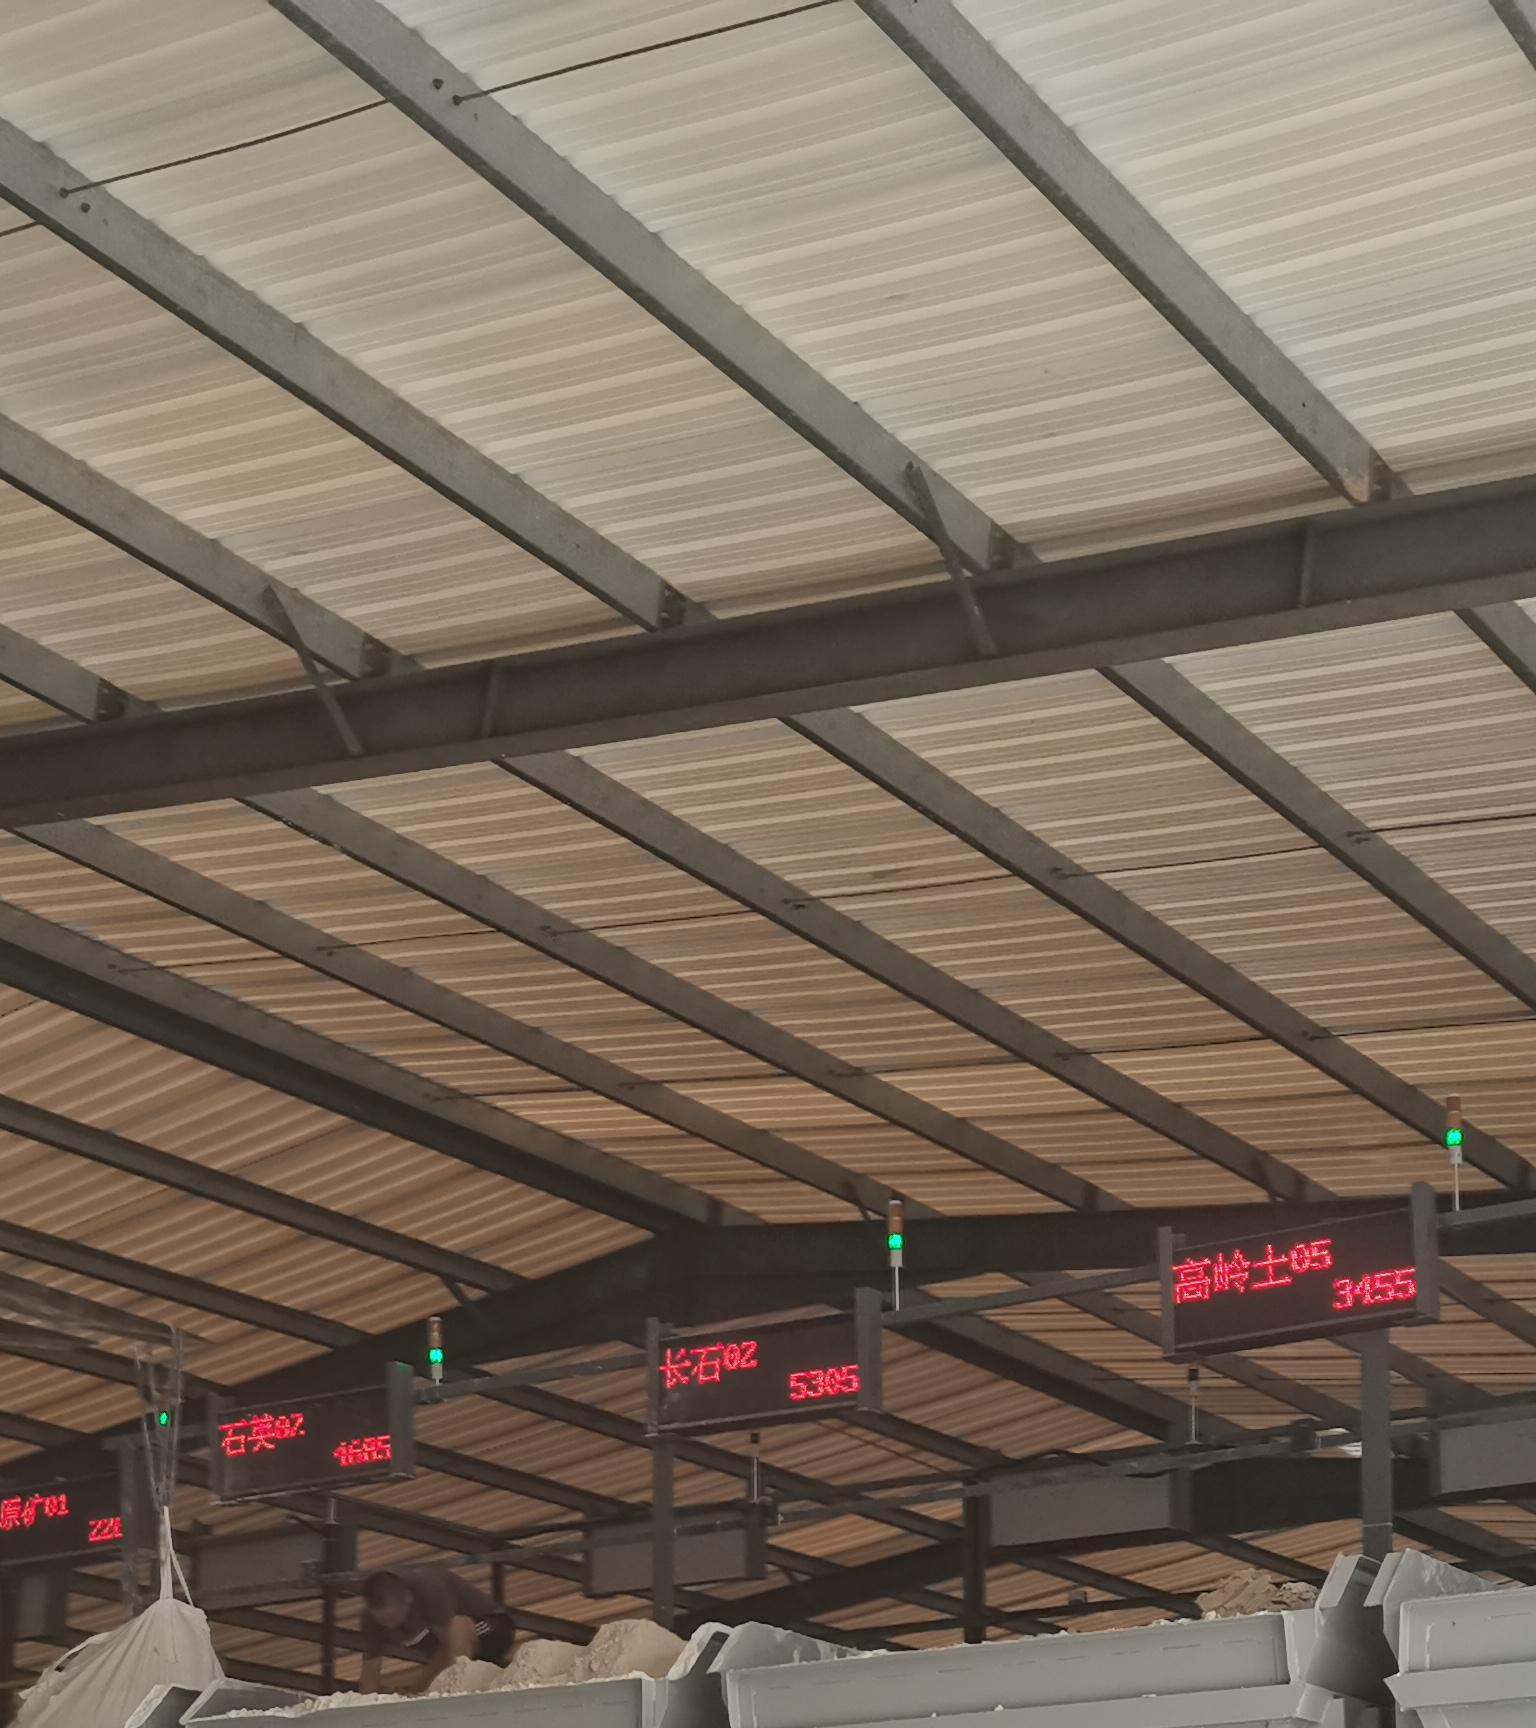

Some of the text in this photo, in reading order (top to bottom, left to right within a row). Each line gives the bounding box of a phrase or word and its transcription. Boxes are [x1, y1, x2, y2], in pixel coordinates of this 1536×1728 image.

[1171, 1238, 1333, 1304] 高岭土05
[1331, 1266, 1417, 1311] 3455
[658, 1340, 759, 1389] 长石02
[788, 1363, 861, 1402] 5305
